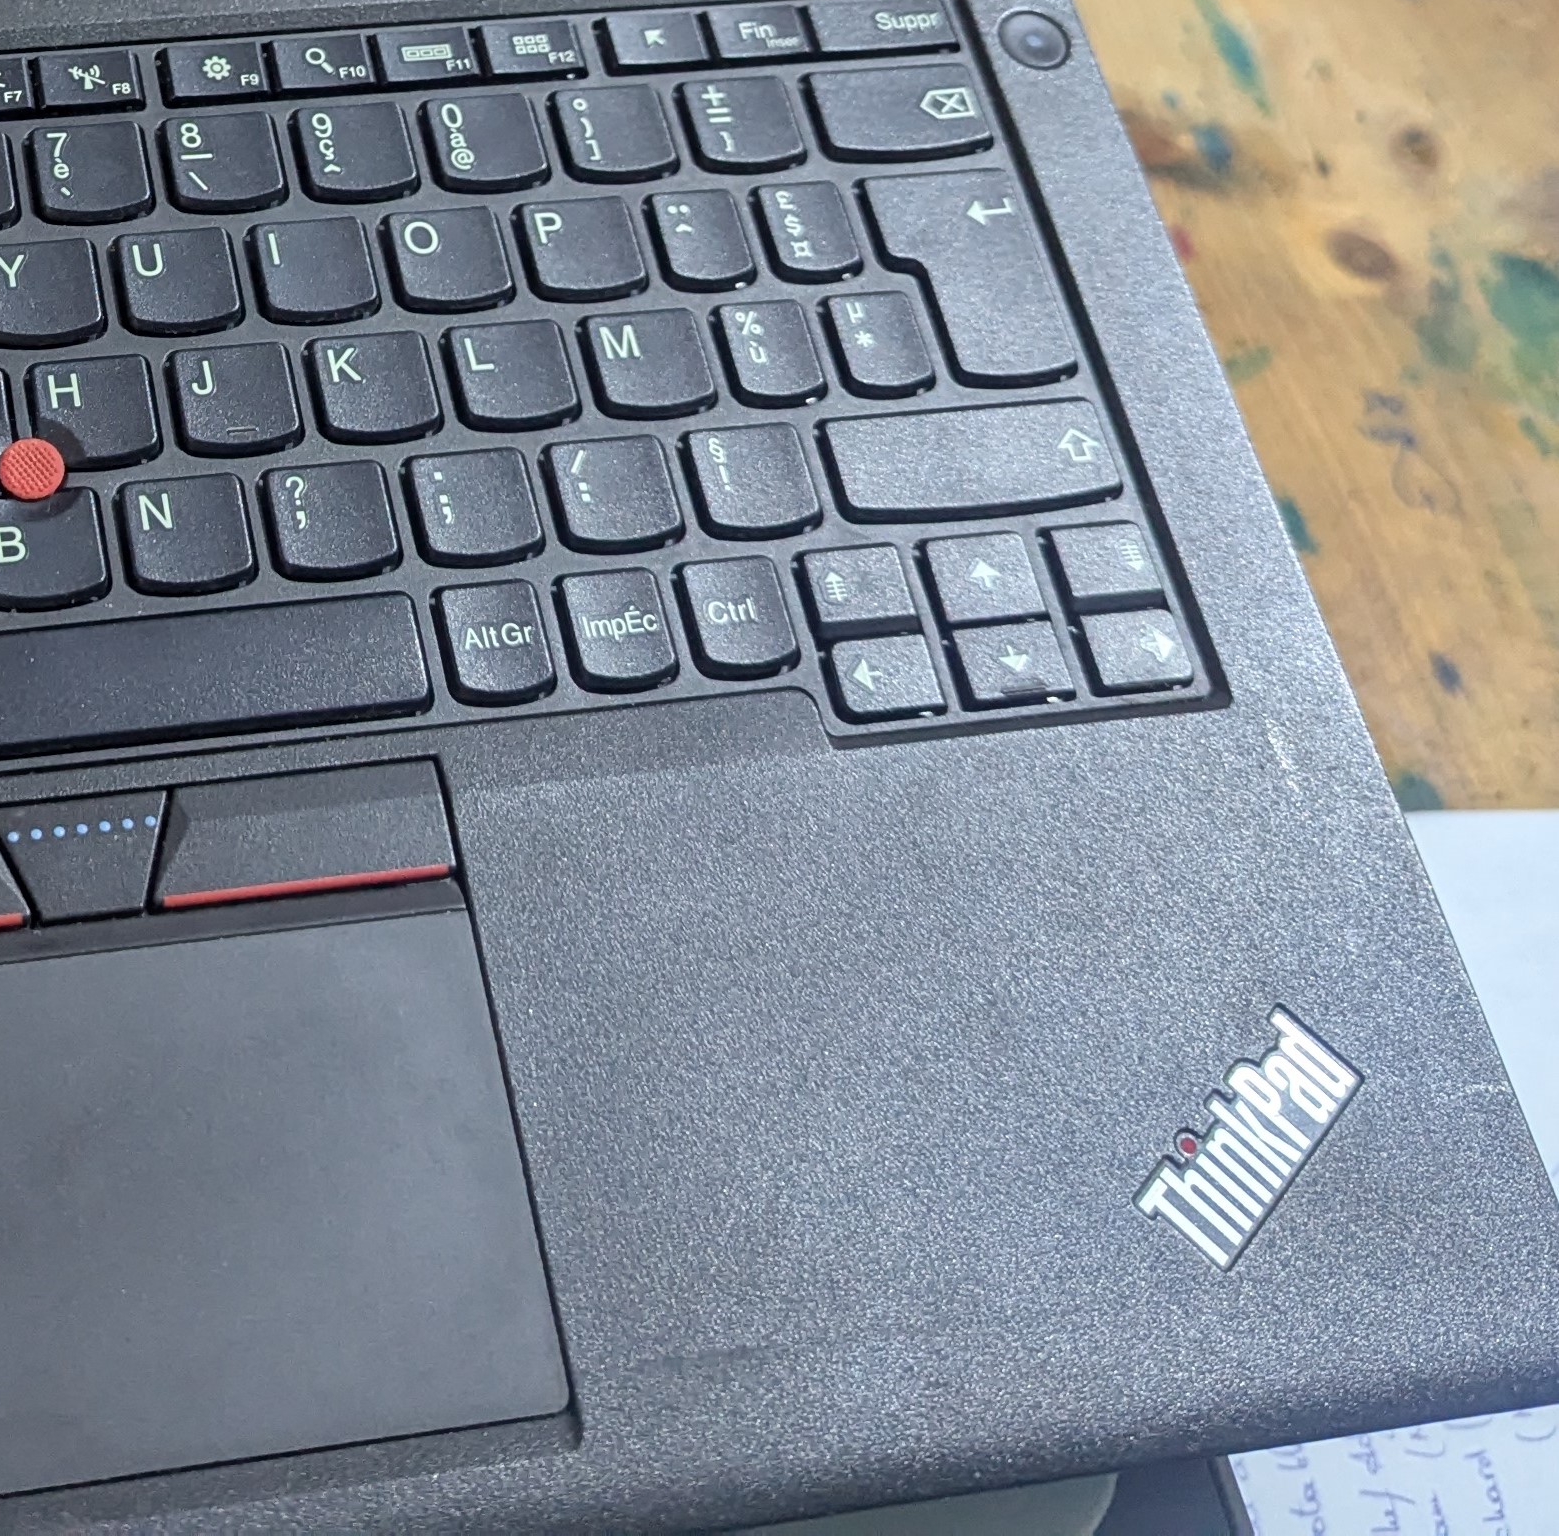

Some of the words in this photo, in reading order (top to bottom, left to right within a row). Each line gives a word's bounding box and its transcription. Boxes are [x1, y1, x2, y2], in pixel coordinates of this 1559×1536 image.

[738, 21, 774, 41] Fin
[875, 12, 939, 31] Suppr
[446, 59, 470, 71] F11
[548, 50, 575, 63] F12
[241, 74, 259, 86] F9
[339, 66, 366, 78] F10
[4, 91, 22, 102] F7
[112, 83, 131, 94] F8
[312, 113, 332, 137] 9
[442, 104, 462, 132] 0
[46, 133, 68, 159] 7
[181, 123, 201, 148] 8
[319, 139, 334, 160] ç
[54, 158, 69, 178] è
[405, 222, 441, 254] O
[534, 213, 562, 246] P
[133, 244, 166, 276] U
[269, 233, 280, 264] I
[464, 338, 494, 370] L
[599, 325, 640, 359] M
[192, 361, 212, 395] J
[327, 348, 366, 383] K
[48, 373, 81, 408] H
[139, 493, 172, 530] N
[580, 606, 659, 641] ImpÉc
[707, 599, 758, 625] Ctrl
[1139, 1011, 1357, 1267] ThinkPad
